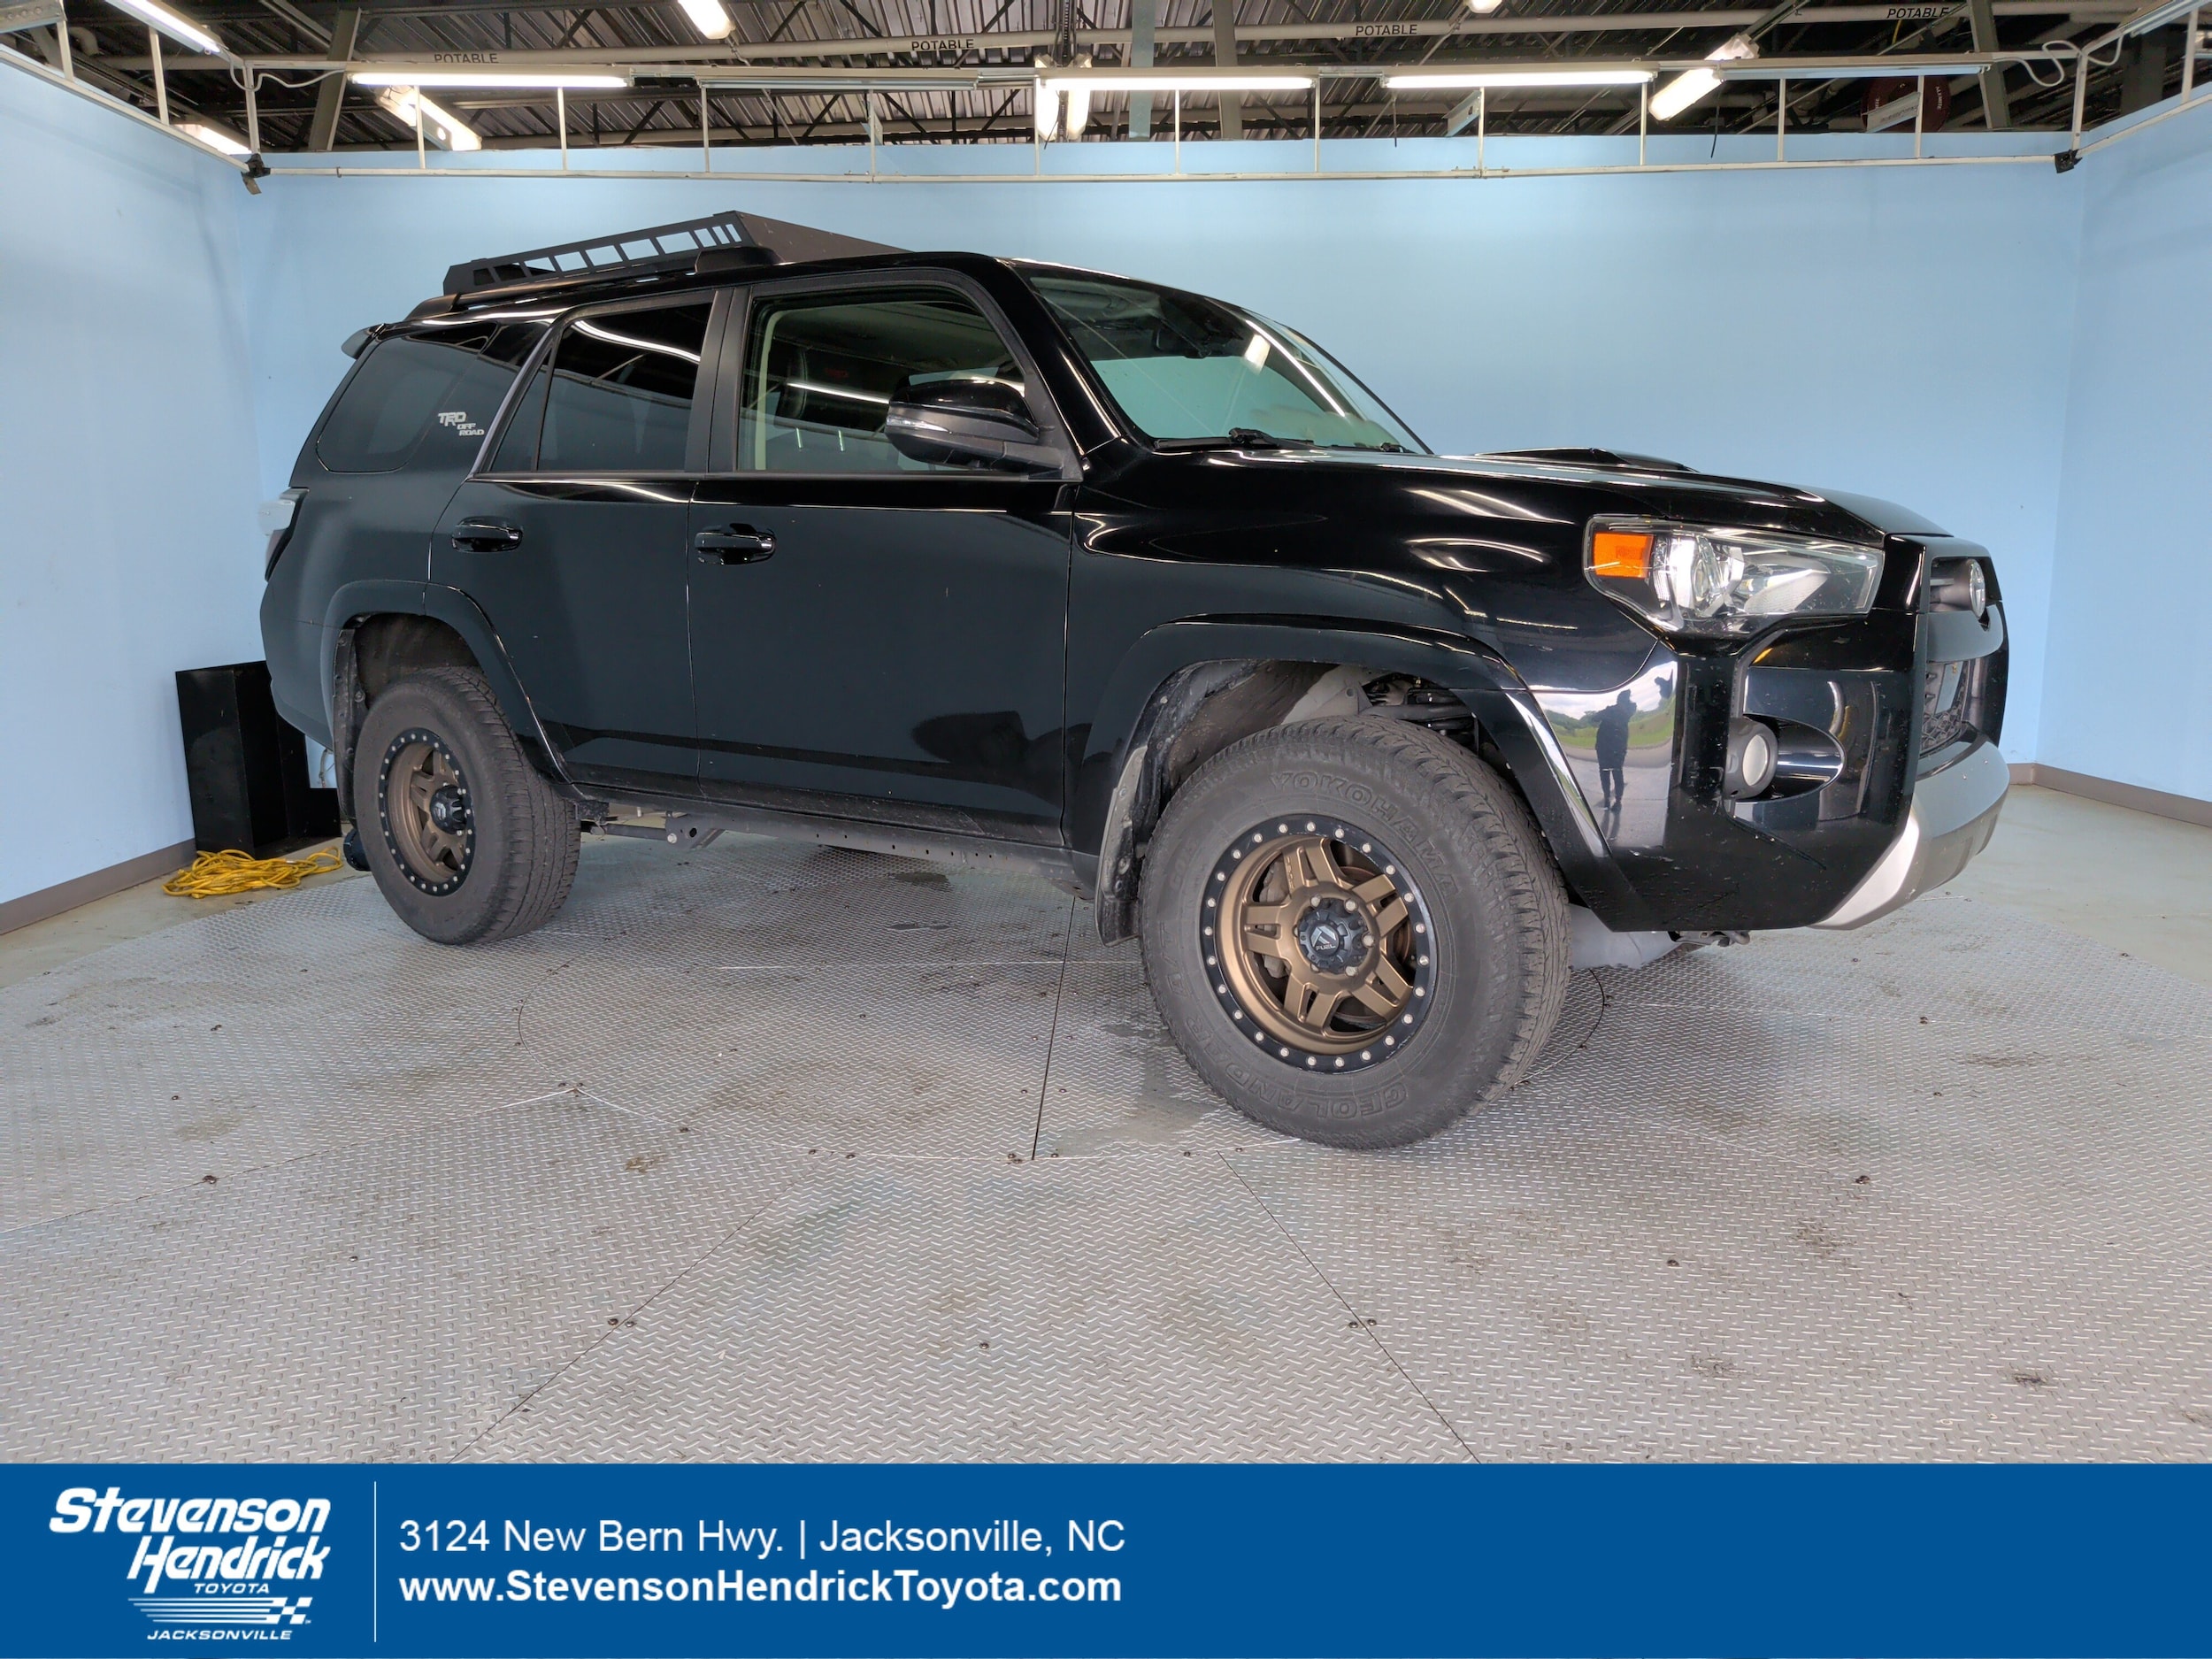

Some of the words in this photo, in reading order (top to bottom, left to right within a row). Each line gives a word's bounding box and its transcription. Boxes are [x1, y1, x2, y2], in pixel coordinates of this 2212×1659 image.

[1886, 6, 1950, 19] POTABLE
[1356, 24, 1417, 36] POTABLE
[911, 38, 974, 50] POTABLE
[434, 53, 499, 64] POTABLE
[437, 411, 467, 426] TRD
[1269, 771, 1461, 897] YOKOHAMA
[1186, 1018, 1409, 1120] GEOLANDAR
